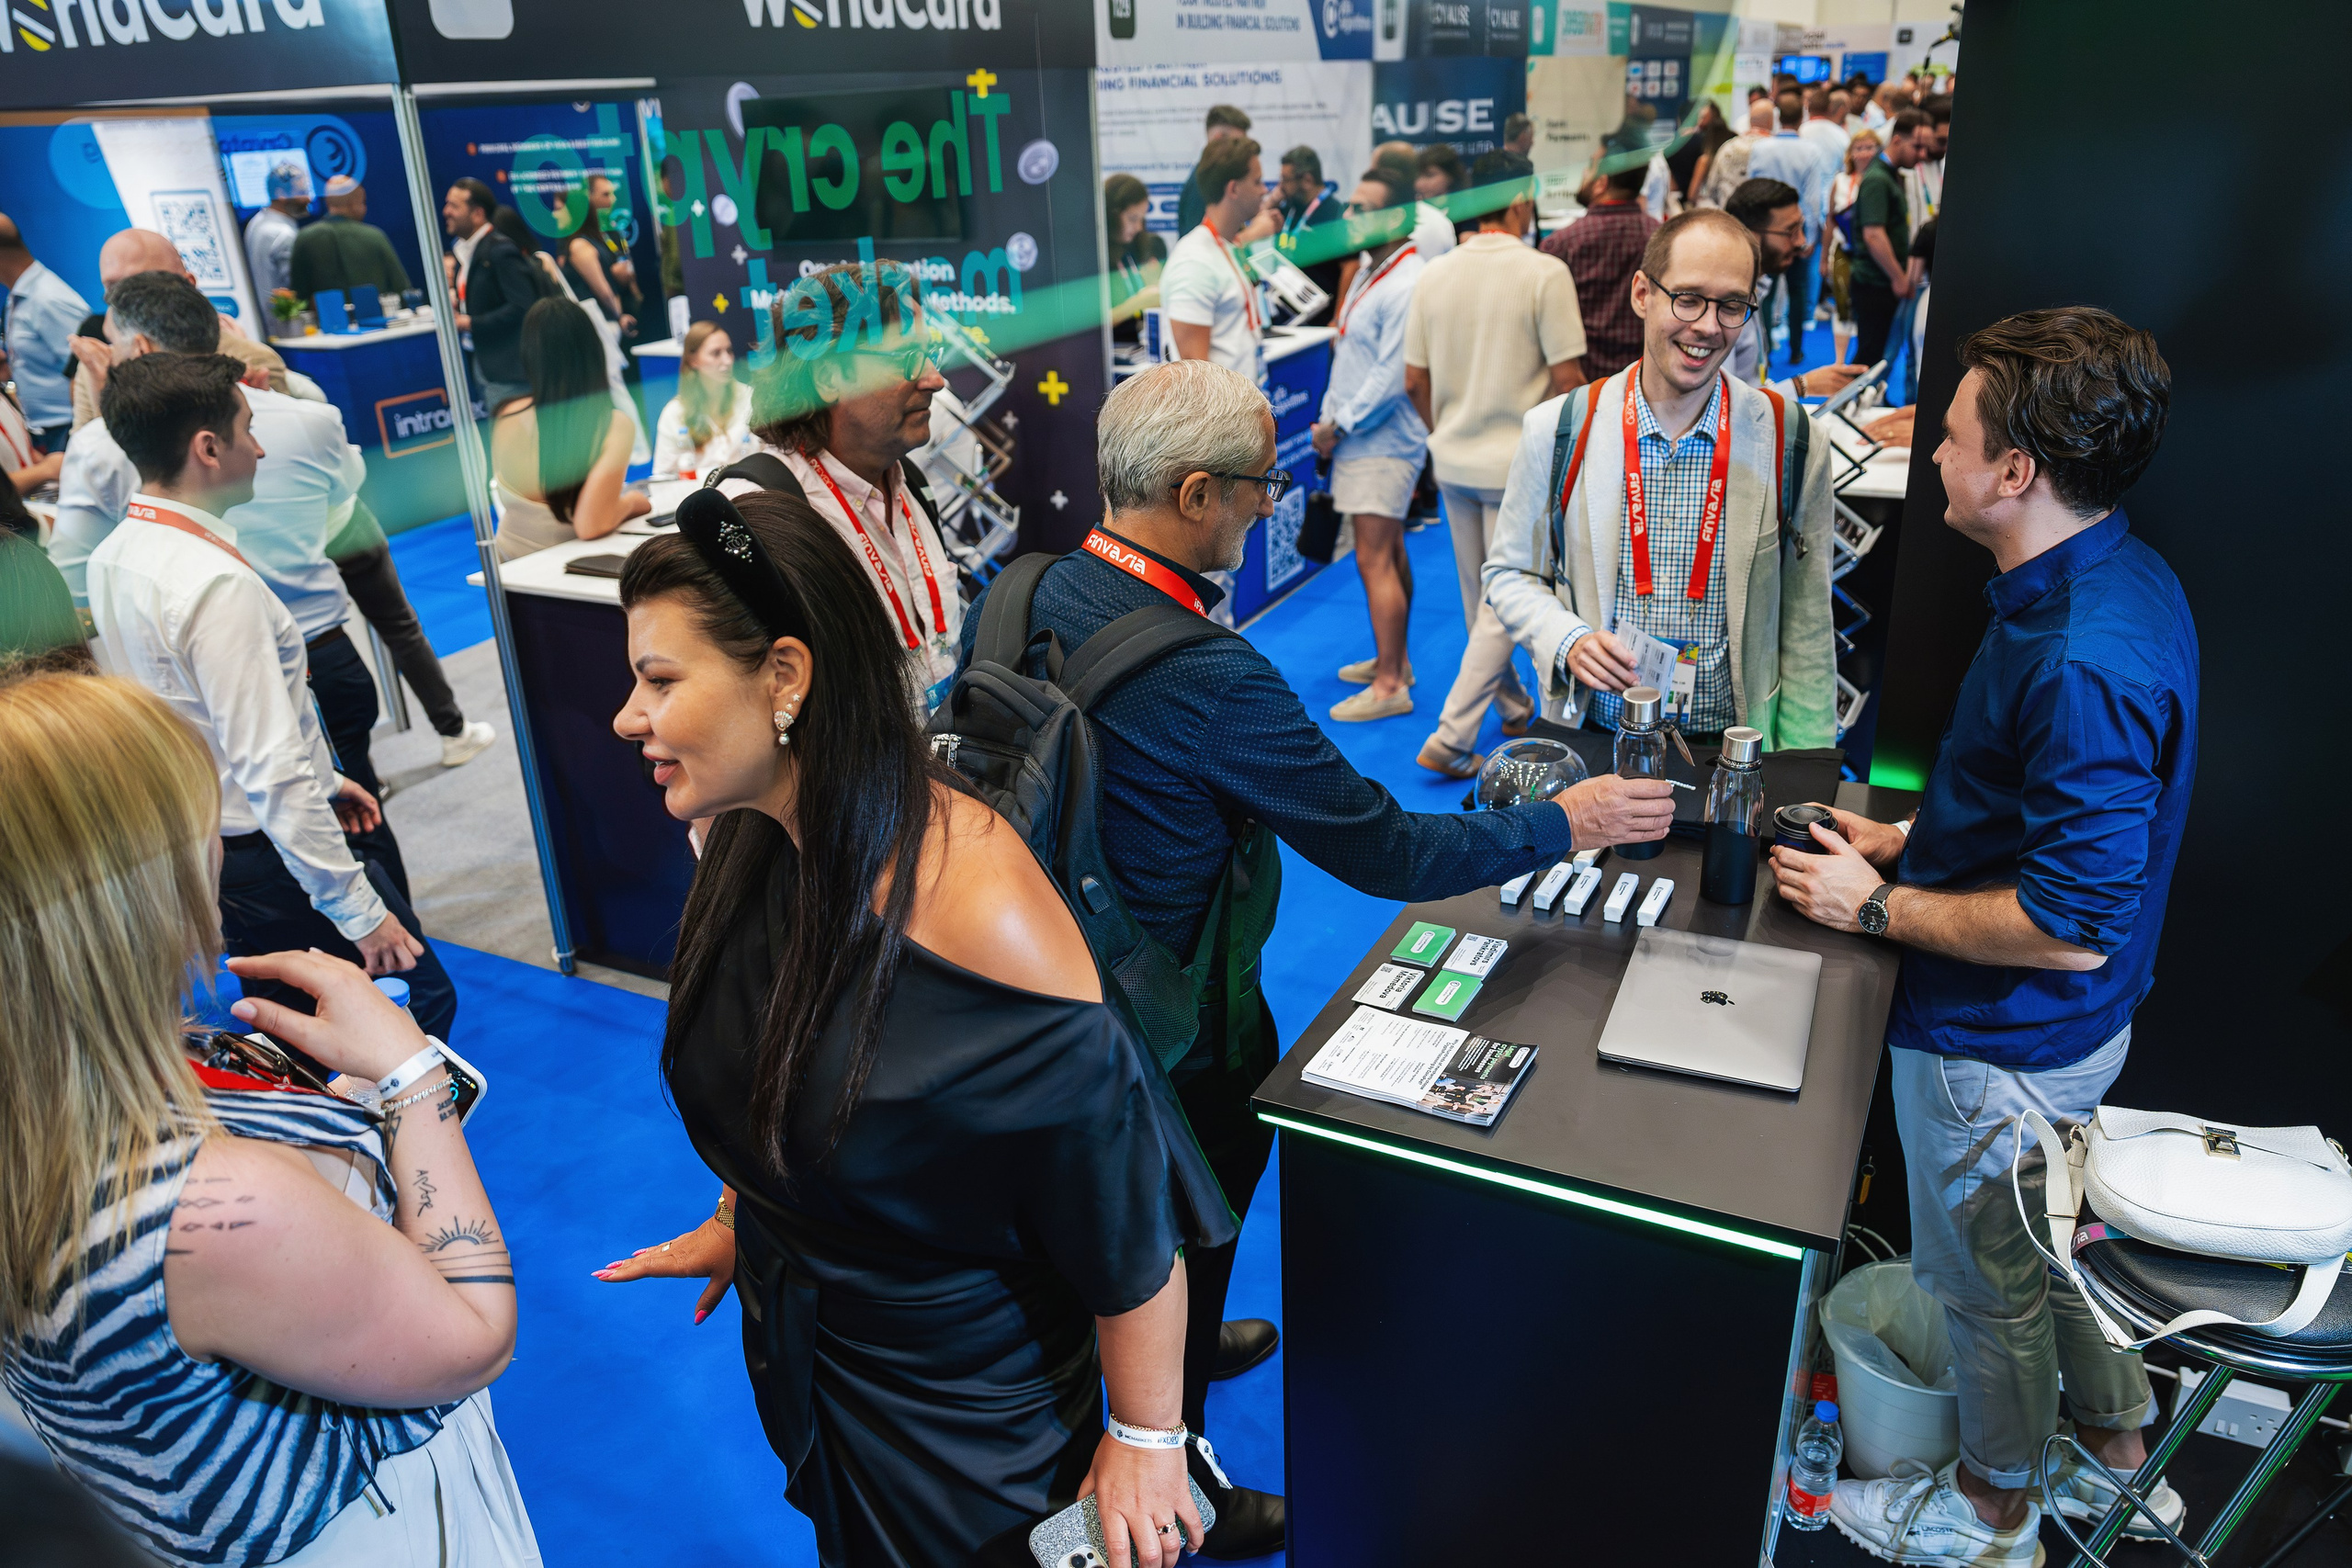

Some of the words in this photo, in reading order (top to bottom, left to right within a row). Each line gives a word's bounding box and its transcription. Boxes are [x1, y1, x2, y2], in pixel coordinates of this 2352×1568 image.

[1468, 938, 1494, 965] Pankratovs
[1379, 970, 1408, 998] Mamedova
[1395, 972, 1418, 993] Viktoria
